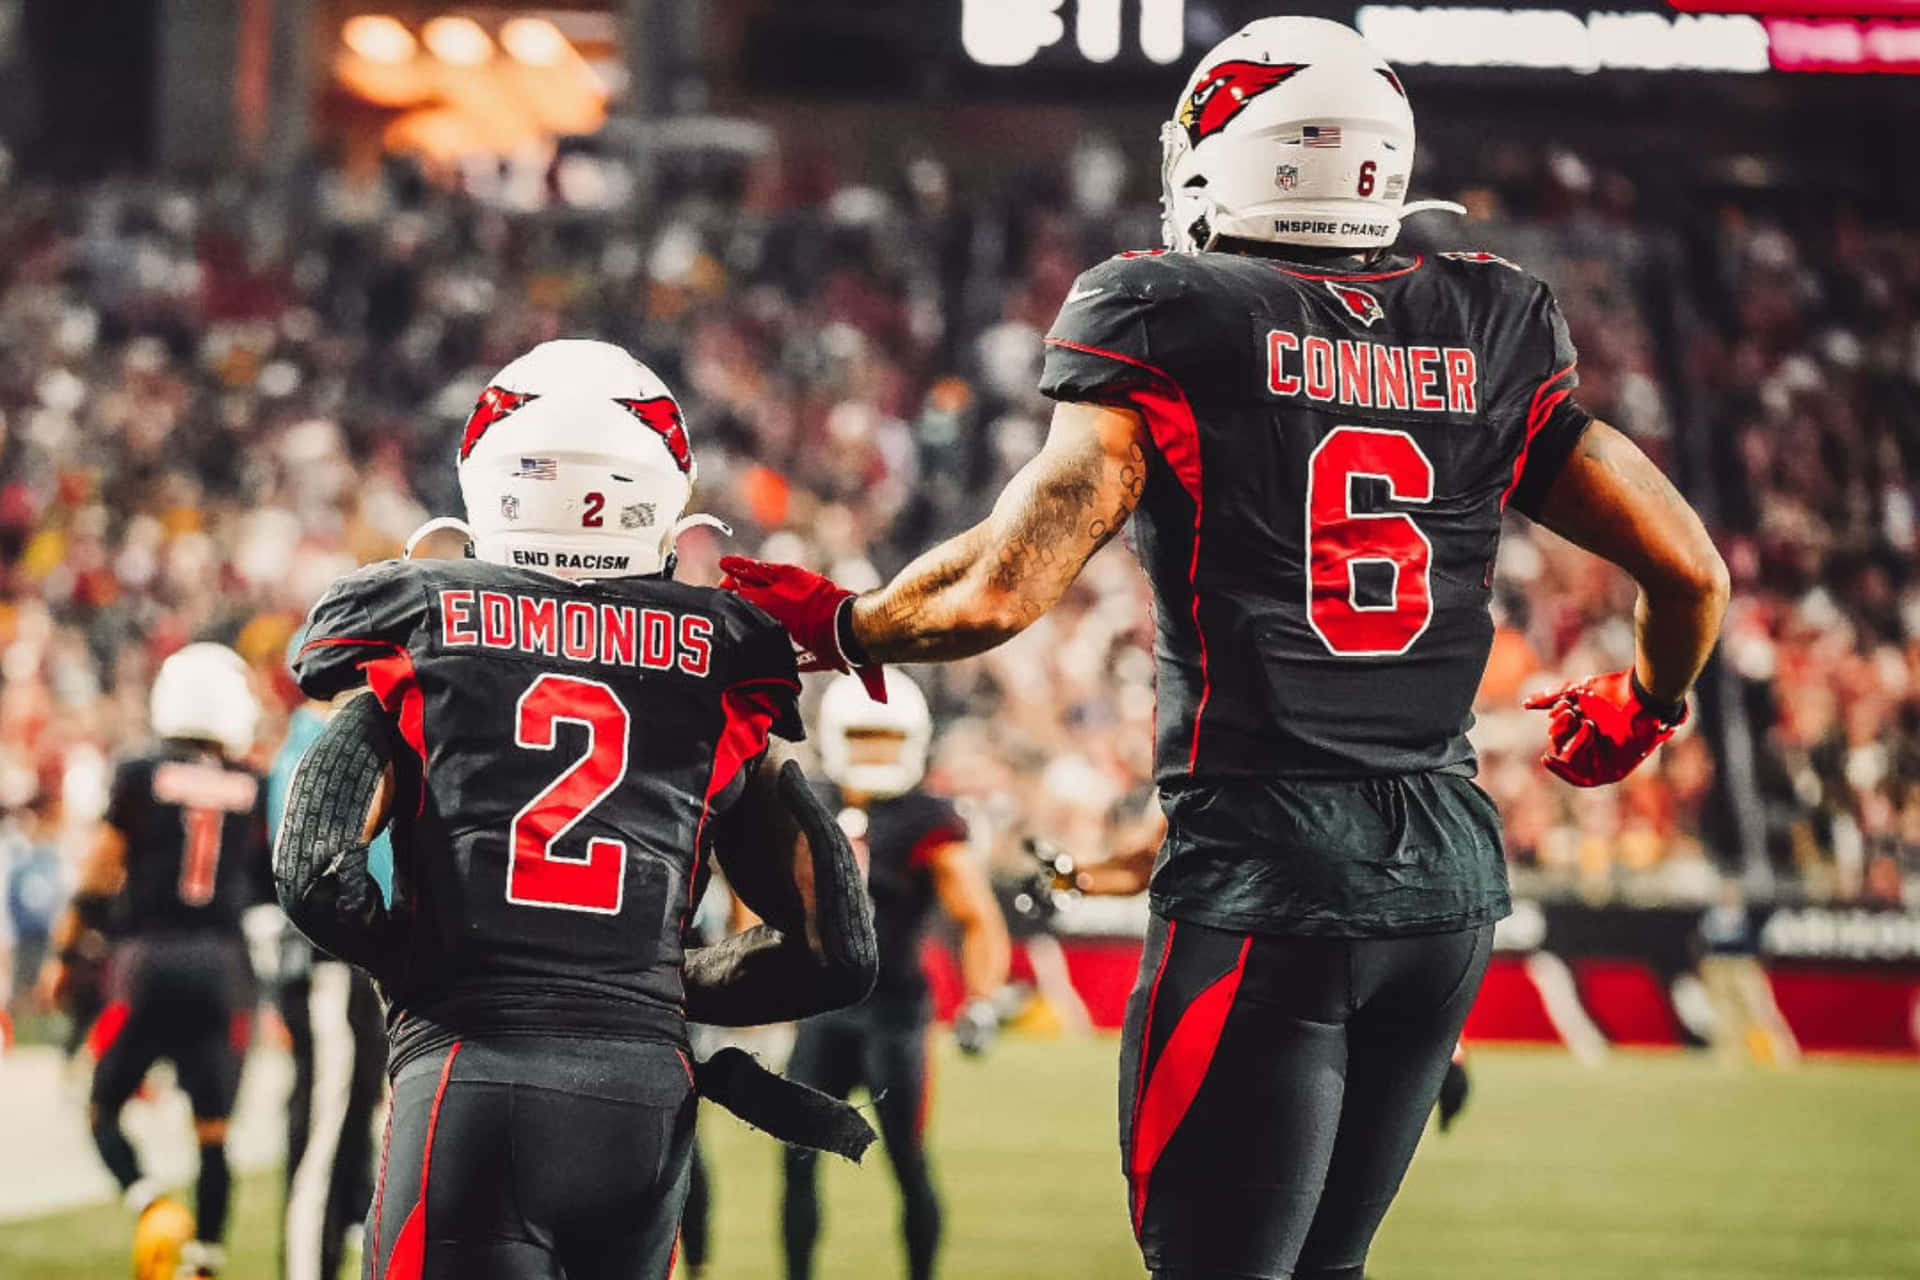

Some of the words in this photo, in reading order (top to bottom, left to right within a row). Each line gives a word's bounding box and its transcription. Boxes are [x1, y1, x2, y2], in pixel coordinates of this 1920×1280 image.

[1357, 160, 1377, 197] 6
[1275, 220, 1337, 235] INSPIRE
[1267, 330, 1477, 414] CONNER
[582, 492, 606, 528] 2
[513, 550, 549, 567] END
[555, 553, 630, 570] RACISM
[1305, 426, 1434, 656] 6
[439, 590, 714, 678] EDMONDS
[506, 673, 631, 915] 2
